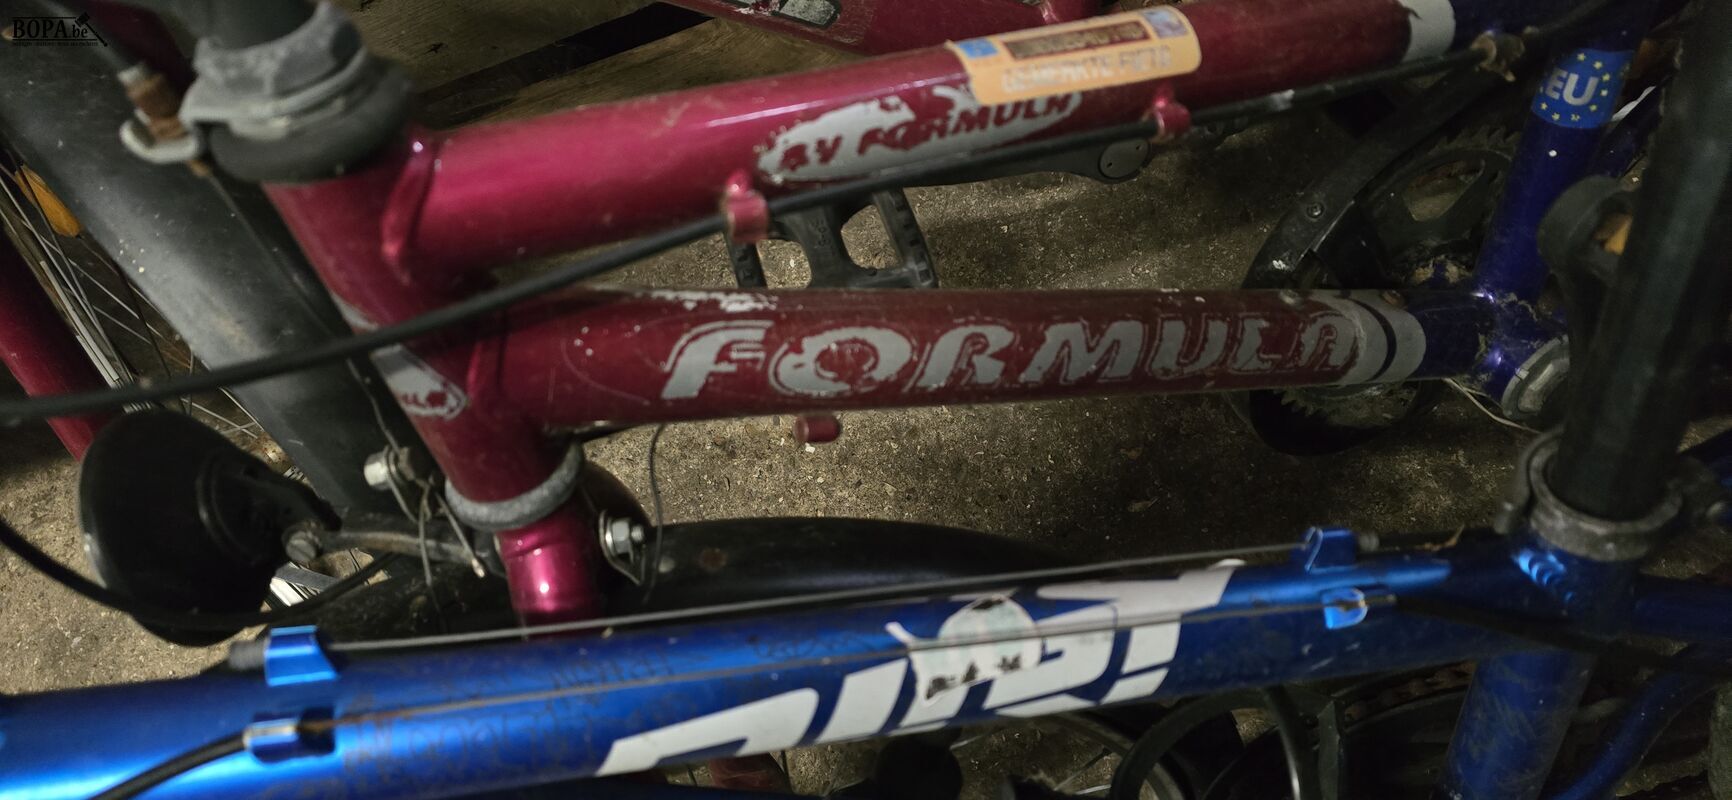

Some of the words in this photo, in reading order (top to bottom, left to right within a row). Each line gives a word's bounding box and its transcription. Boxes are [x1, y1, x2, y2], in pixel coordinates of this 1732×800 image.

[1545, 67, 1600, 106] EU
[779, 134, 843, 172] BY
[661, 318, 1357, 400] FORMULA
